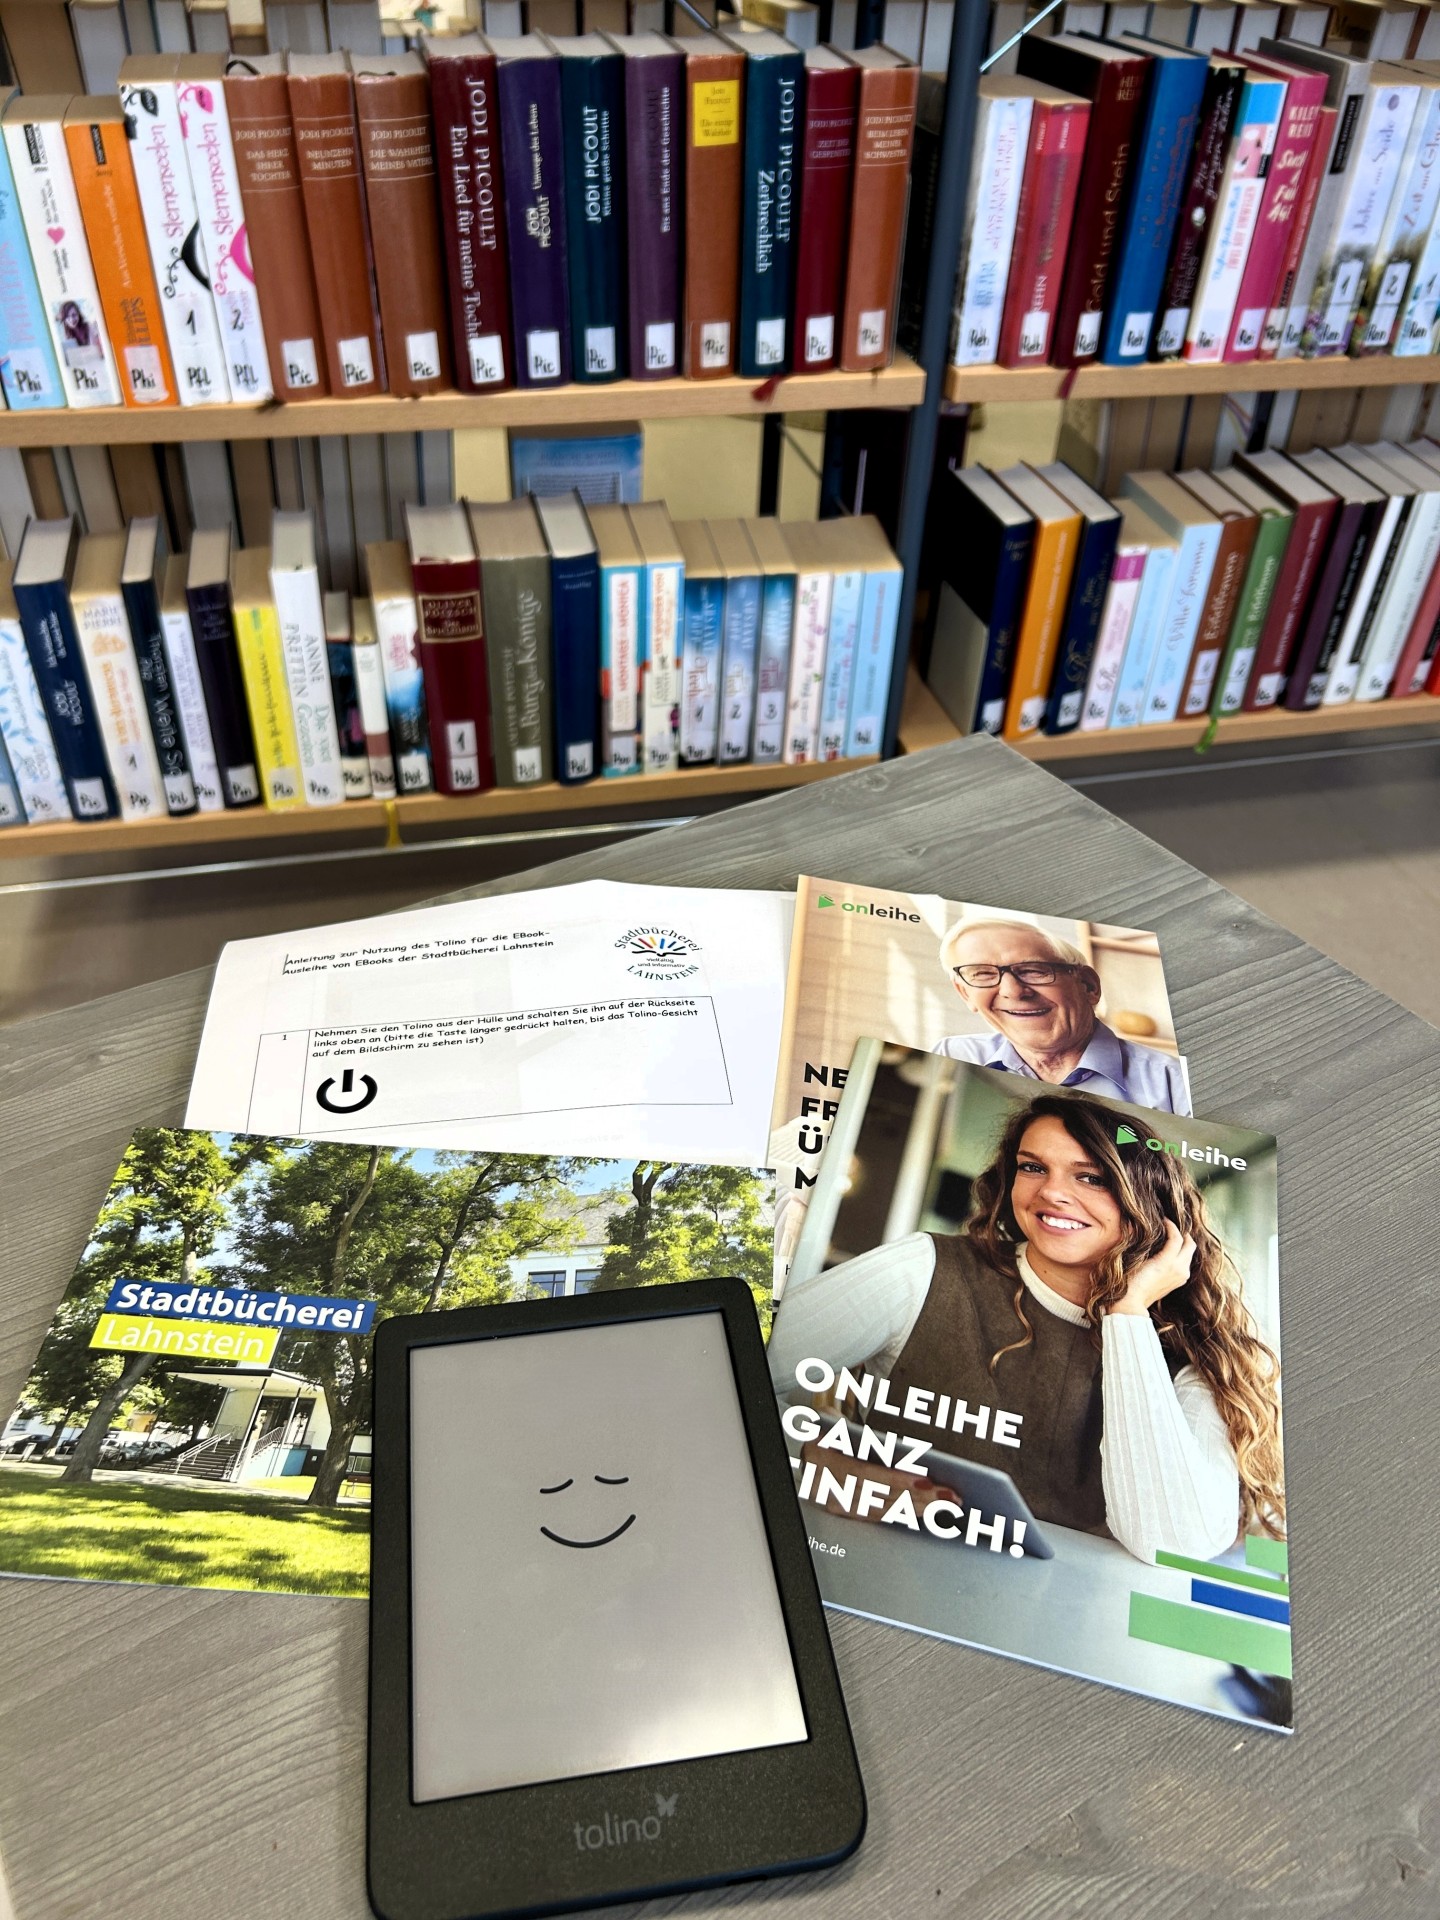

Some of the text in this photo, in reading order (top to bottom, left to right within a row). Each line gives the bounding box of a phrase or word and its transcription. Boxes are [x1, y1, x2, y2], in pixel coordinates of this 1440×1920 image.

[236, 126, 292, 141] JODI PICOULT
[300, 126, 355, 140] JODI PICOULT
[371, 126, 427, 140] JODI PICOULT
[529, 103, 543, 190] Umwege des Lebens
[312, 158, 352, 170] MINUTEN
[465, 75, 497, 250] JODI PICOULT
[583, 105, 602, 224] JODI PICOULT
[600, 110, 612, 217] Kleine große Schritte
[660, 86, 671, 233] Bis ans Ende der Geschichte
[775, 78, 795, 243] JODI PICOULT
[451, 125, 482, 339] Ein Lied für meine Tocht
[526, 207, 540, 236] JODI
[536, 195, 551, 249] PICOULT
[756, 170, 775, 273] Zerbrechlich
[1086, 143, 1130, 313] Gold und Stein
[1386, 275, 1399, 297] 2
[186, 310, 196, 335] 1
[232, 308, 244, 331] 2
[72, 367, 98, 390] Phi
[131, 368, 156, 390] Phi
[285, 623, 309, 697] PRETTIN
[304, 633, 325, 683] ANNE
[517, 589, 545, 728] Burg Könige
[731, 704, 742, 720] 2
[766, 703, 777, 719] 3
[457, 731, 466, 750] 1
[841, 898, 922, 925] onleihe
[286, 954, 335, 965] Anleitung
[362, 945, 407, 956] Nutzung
[411, 941, 430, 950] des
[435, 938, 466, 947] Tolino
[471, 935, 488, 944] für
[492, 933, 509, 941] die
[513, 930, 551, 939] EBook-
[614, 926, 703, 951] Stadtbücherei
[283, 939, 554, 975] Ausleihe von EBooks der Stadtbücherei Lahnstein
[626, 964, 700, 981] LAHNSTEIN
[314, 1029, 357, 1038] Nehmen
[403, 1022, 433, 1030] Tolino
[477, 1015, 503, 1024] Hülle
[506, 1014, 524, 1022] und
[527, 1009, 569, 1020] schalten
[572, 1007, 588, 1015] Sie
[591, 1004, 606, 1012] ihn
[608, 1002, 625, 1010] auf
[628, 1000, 645, 1008] der
[647, 999, 695, 1008] Rückseite
[314, 1039, 338, 1047] links
[340, 1036, 366, 1045] oben
[384, 1033, 414, 1043] (bitte
[437, 1028, 467, 1037] Taste
[470, 1025, 502, 1035] länger
[504, 1021, 550, 1033] gedrückt
[553, 1017, 588, 1028] halten,
[590, 1015, 605, 1023] bis
[607, 1012, 625, 1021] das
[627, 1009, 699, 1018] Tolino-Gesicht
[312, 1049, 330, 1058] auf
[333, 1048, 356, 1056] dem
[359, 1042, 415, 1054] Bildschirm
[432, 1038, 463, 1047] sehen
[465, 1036, 485, 1045] ist)
[802, 1062, 848, 1089] NE
[801, 1096, 840, 1121] FR
[1145, 1135, 1249, 1172] onleihe
[794, 1166, 819, 1190] M
[115, 1283, 368, 1331] Stadtbücherei
[100, 1318, 266, 1360] Lahnstein
[794, 1356, 1025, 1449] ONLEIHE
[781, 1405, 934, 1477] GANZ
[807, 1536, 847, 1559] ihe.de
[573, 1811, 662, 1851] tolino
